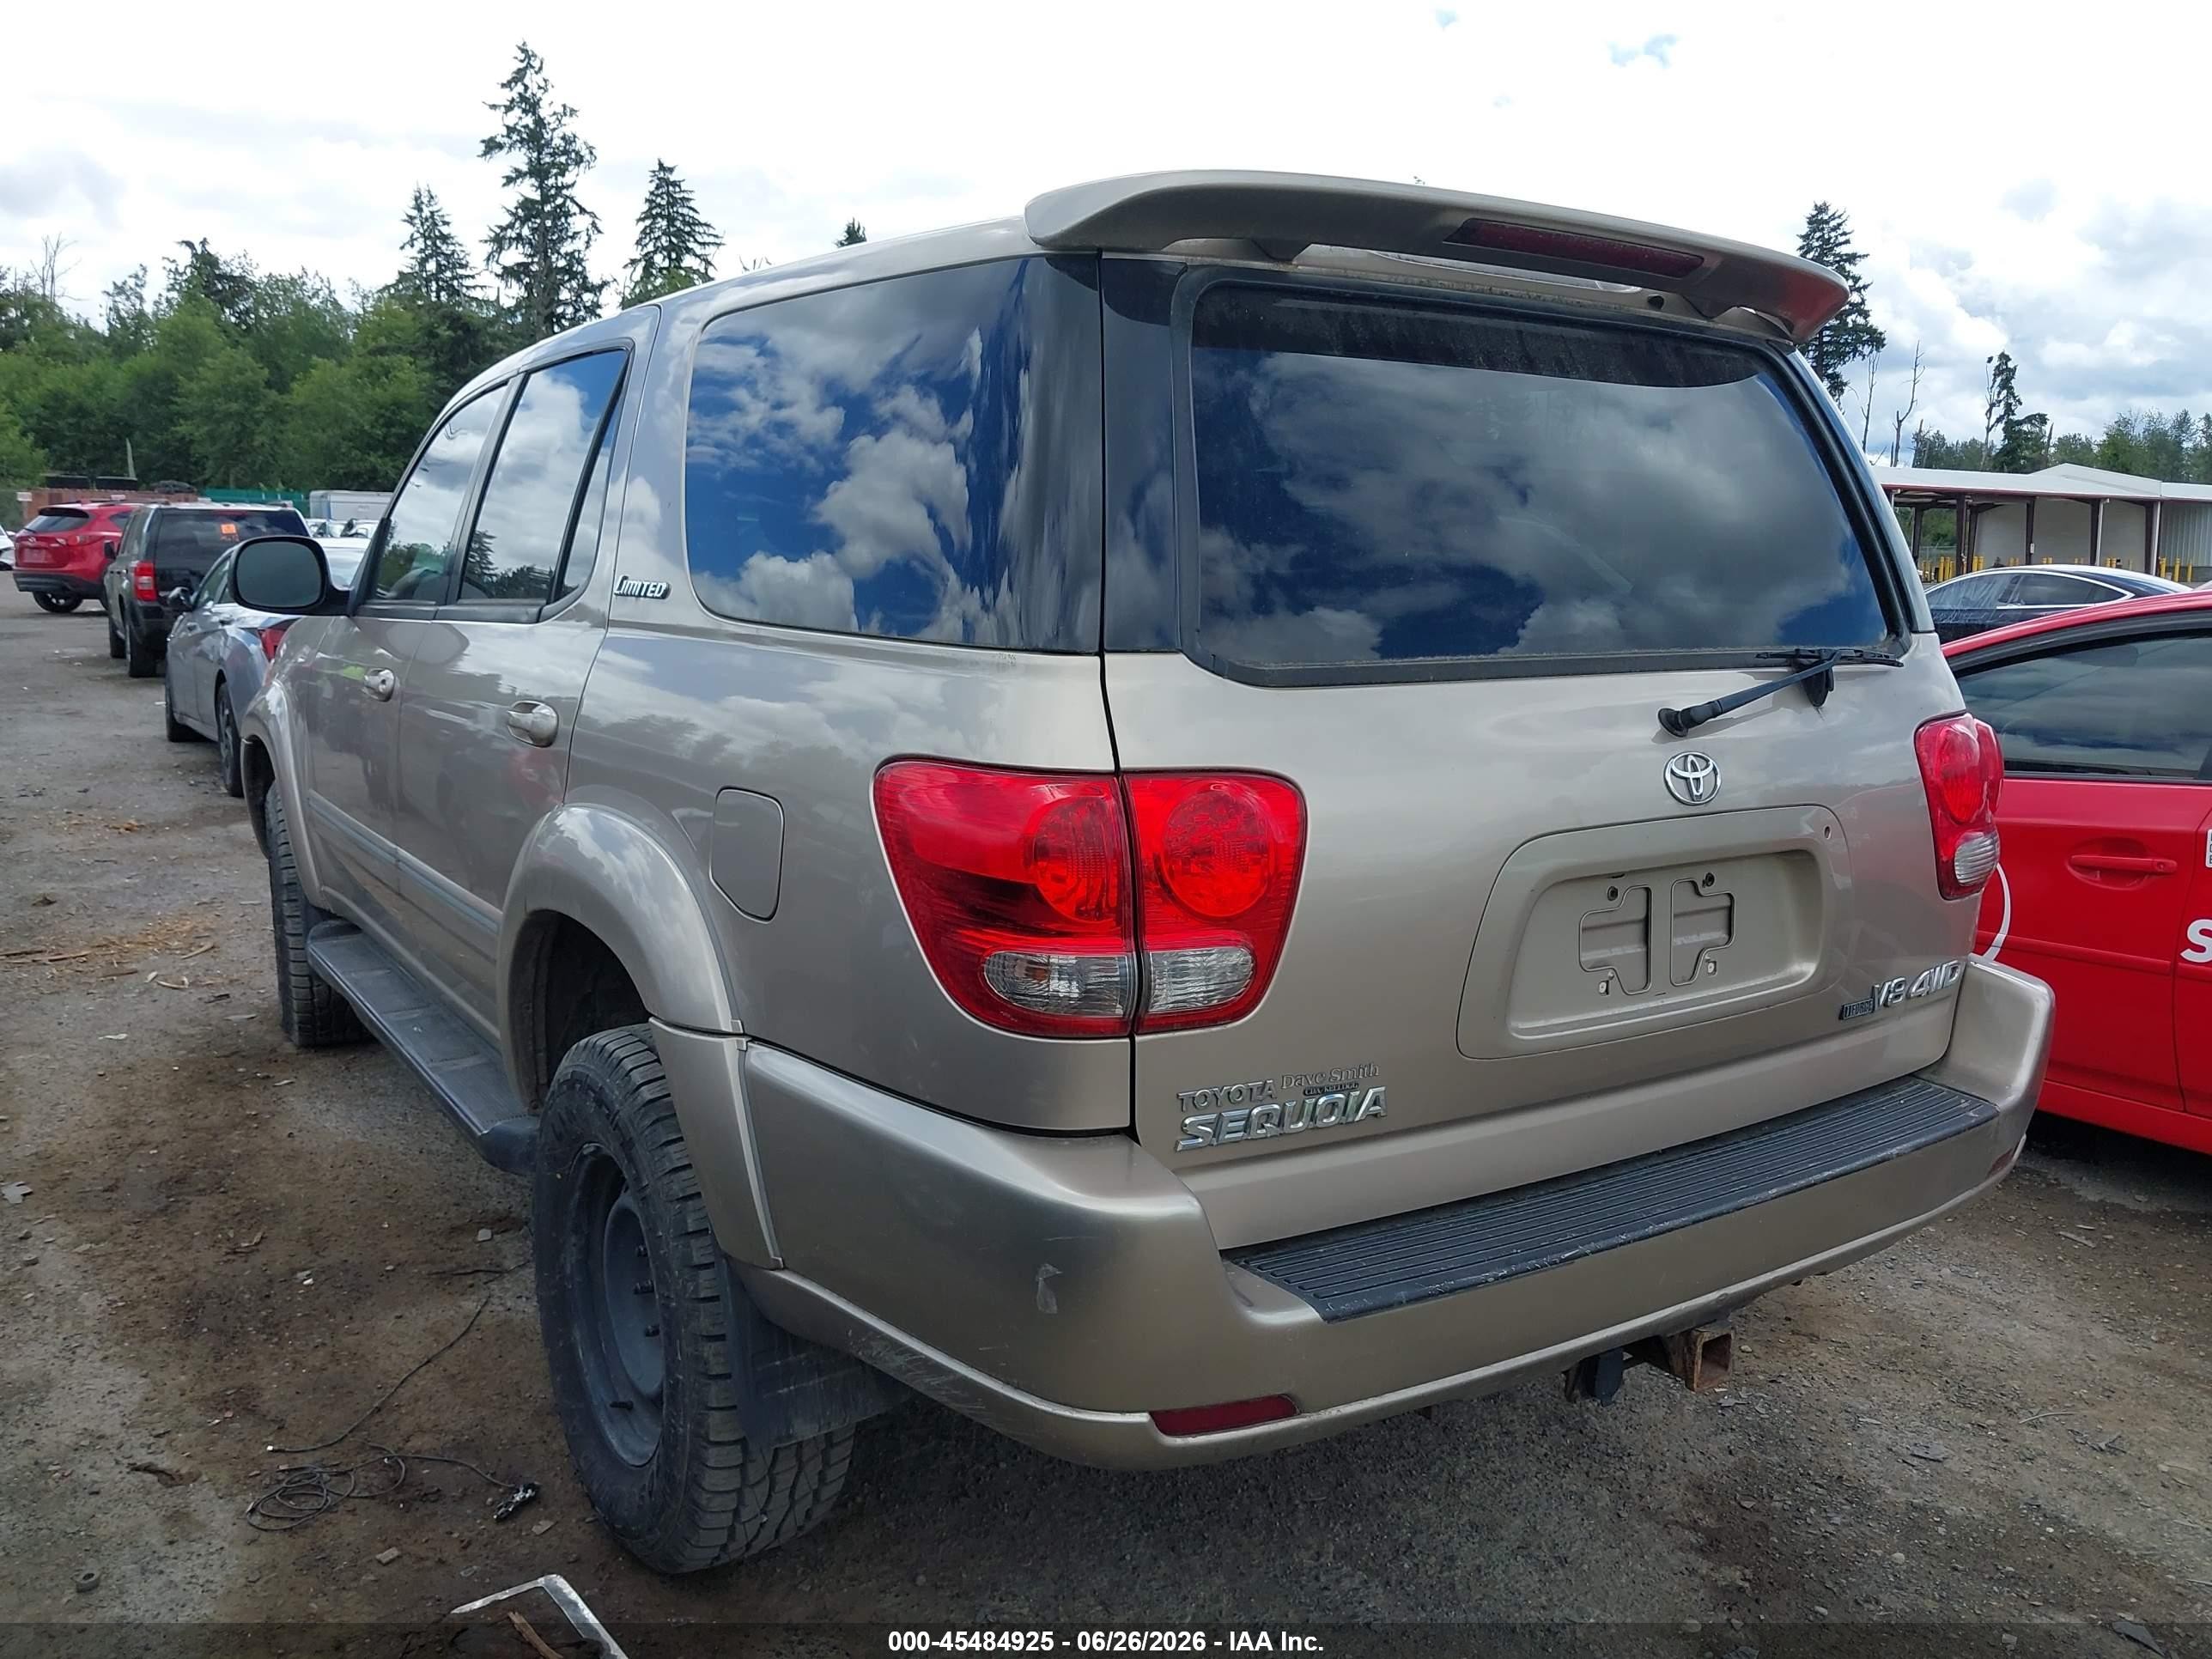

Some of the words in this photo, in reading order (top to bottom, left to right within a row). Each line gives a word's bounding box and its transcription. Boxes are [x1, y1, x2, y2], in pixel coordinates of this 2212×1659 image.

[1874, 977, 1906, 1011] V8
[1910, 960, 1961, 997] 4WD
[1176, 1079, 1277, 1112] TOYOTA
[1281, 1073, 1326, 1089] Dave
[1329, 1062, 1379, 1084] Smith
[1174, 1086, 1388, 1152] SEQUOIA
